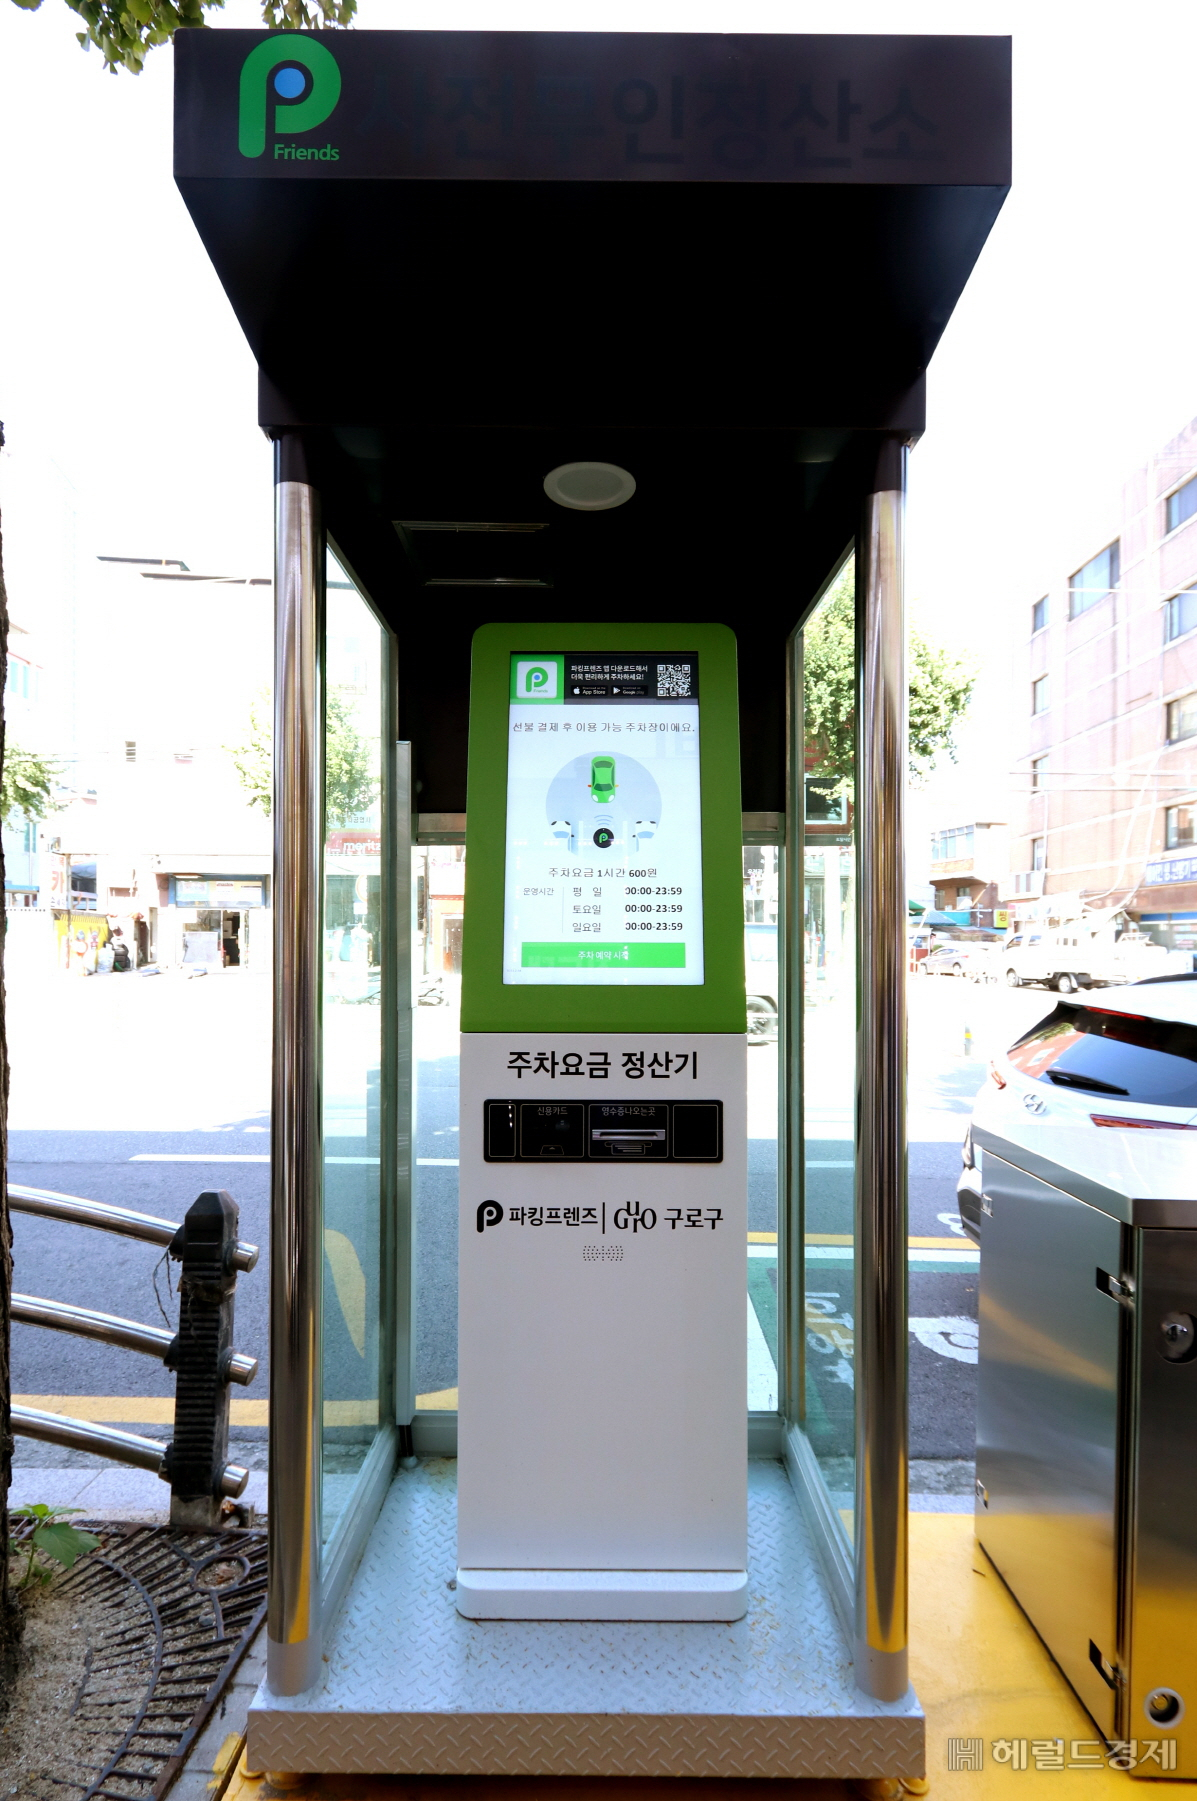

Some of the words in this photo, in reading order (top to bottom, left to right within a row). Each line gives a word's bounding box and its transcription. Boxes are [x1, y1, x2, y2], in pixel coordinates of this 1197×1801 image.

[273, 143, 340, 161] Friends
[571, 665, 602, 673] 파킹프렌즈
[611, 665, 648, 673] 다운로드해서
[512, 722, 534, 733] 선불
[537, 722, 559, 733] 결제
[562, 722, 573, 733] 후
[576, 722, 598, 733] 이용
[600, 722, 622, 733] 가능
[625, 722, 696, 733] 주차장이에요.
[548, 868, 594, 878] 주차요금
[597, 868, 626, 878] 1시간
[628, 868, 658, 878] 600원
[523, 887, 555, 896] 운영시간
[625, 886, 683, 896] 00:00-23:59
[572, 905, 602, 914] 토요일
[625, 904, 683, 913] 00:00-23:59
[572, 922, 602, 932] 일요일
[625, 922, 683, 931] 00:00-23:59
[577, 951, 594, 960] 주차
[596, 951, 612, 960] 예약
[507, 1051, 611, 1079] 주차요금
[621, 1051, 698, 1079] 정산기
[537, 1107, 568, 1116] 신용카드
[601, 1107, 656, 1117] 영수증나오는곳
[509, 1206, 598, 1226] 파킹프렌즈
[663, 1208, 724, 1230] 구로구
